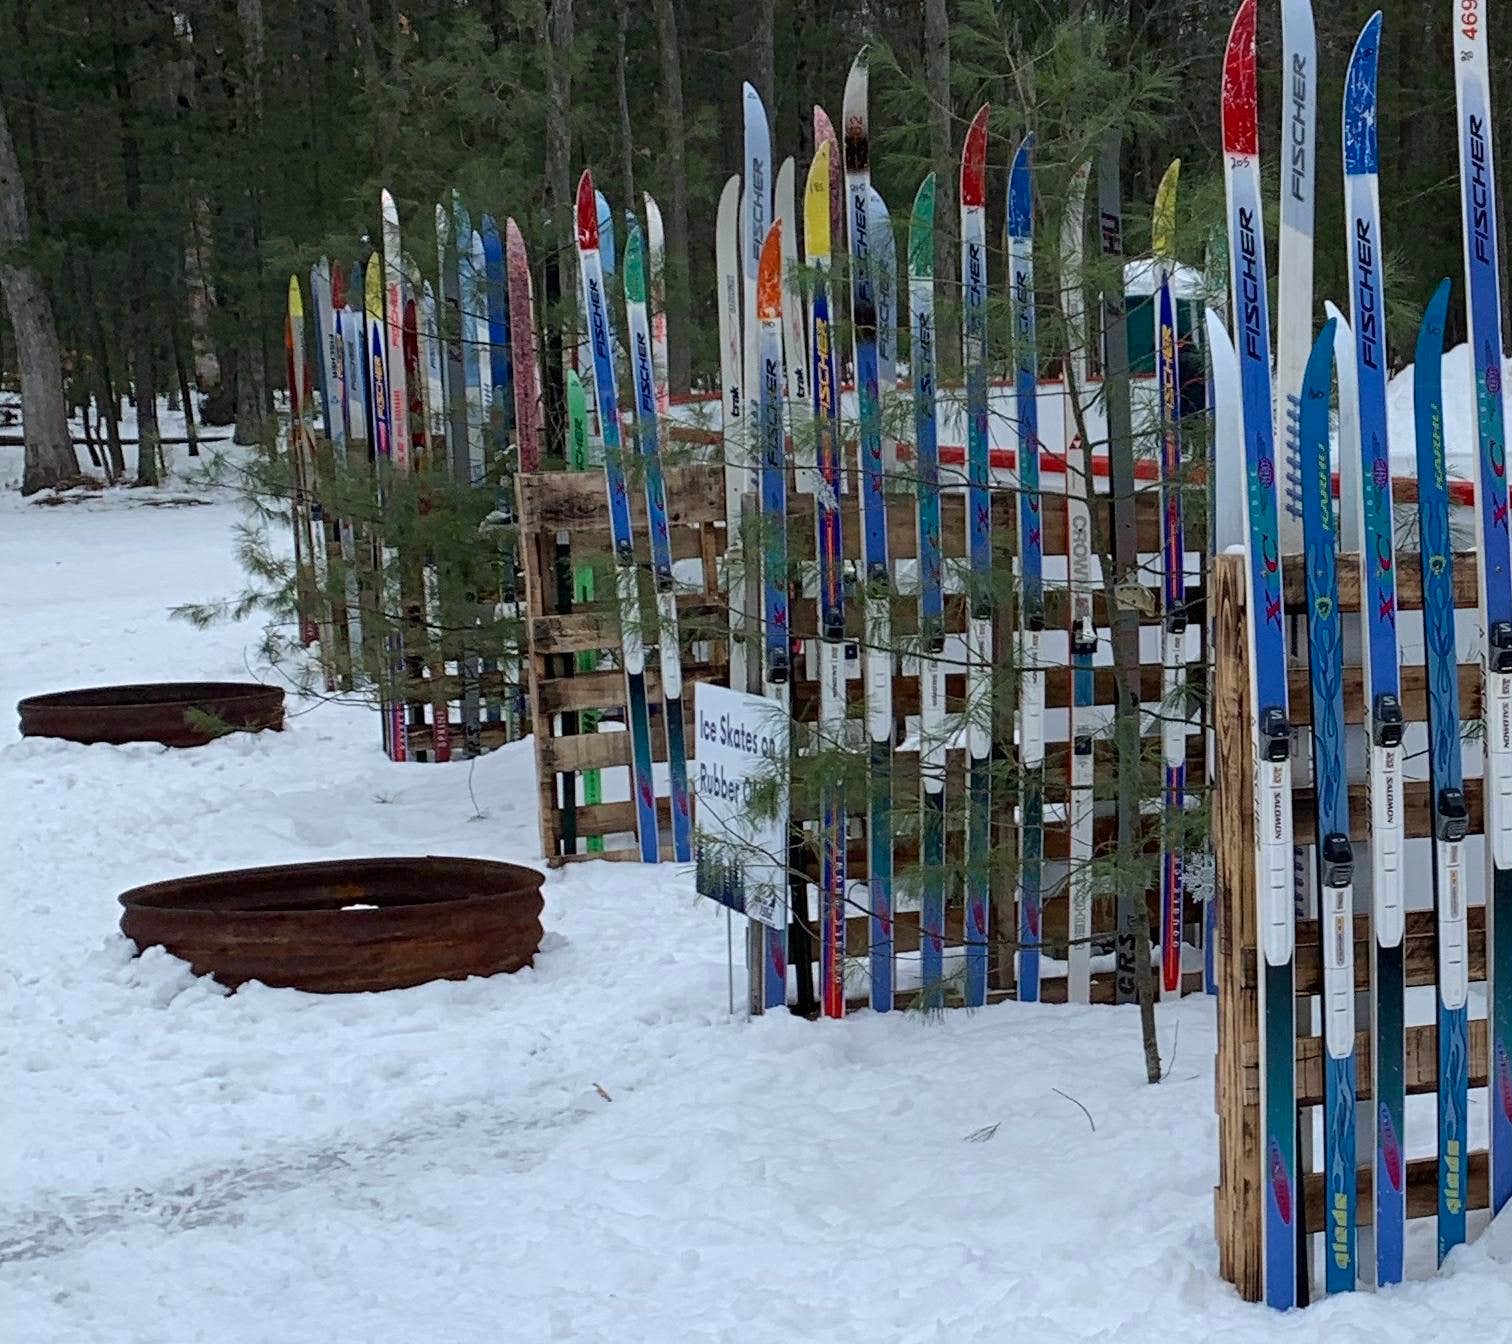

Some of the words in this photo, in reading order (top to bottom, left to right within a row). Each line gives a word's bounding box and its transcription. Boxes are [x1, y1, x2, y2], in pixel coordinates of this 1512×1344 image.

[1291, 53, 1307, 202] FISCHER
[753, 158, 764, 260] FISCHER
[1470, 114, 1490, 264] FISCHER
[590, 278, 607, 360] FISCHER
[1239, 206, 1262, 362] FISCHER
[1357, 217, 1378, 371] FISCHER
[636, 332, 652, 412] FISCHER
[700, 710, 716, 743] Ice
[720, 712, 757, 755] Skates
[700, 763, 739, 804] Rubber
[1274, 791, 1282, 841] SALOMON
[1443, 1140, 1461, 1215] glade
[1332, 1192, 1351, 1270] glade
